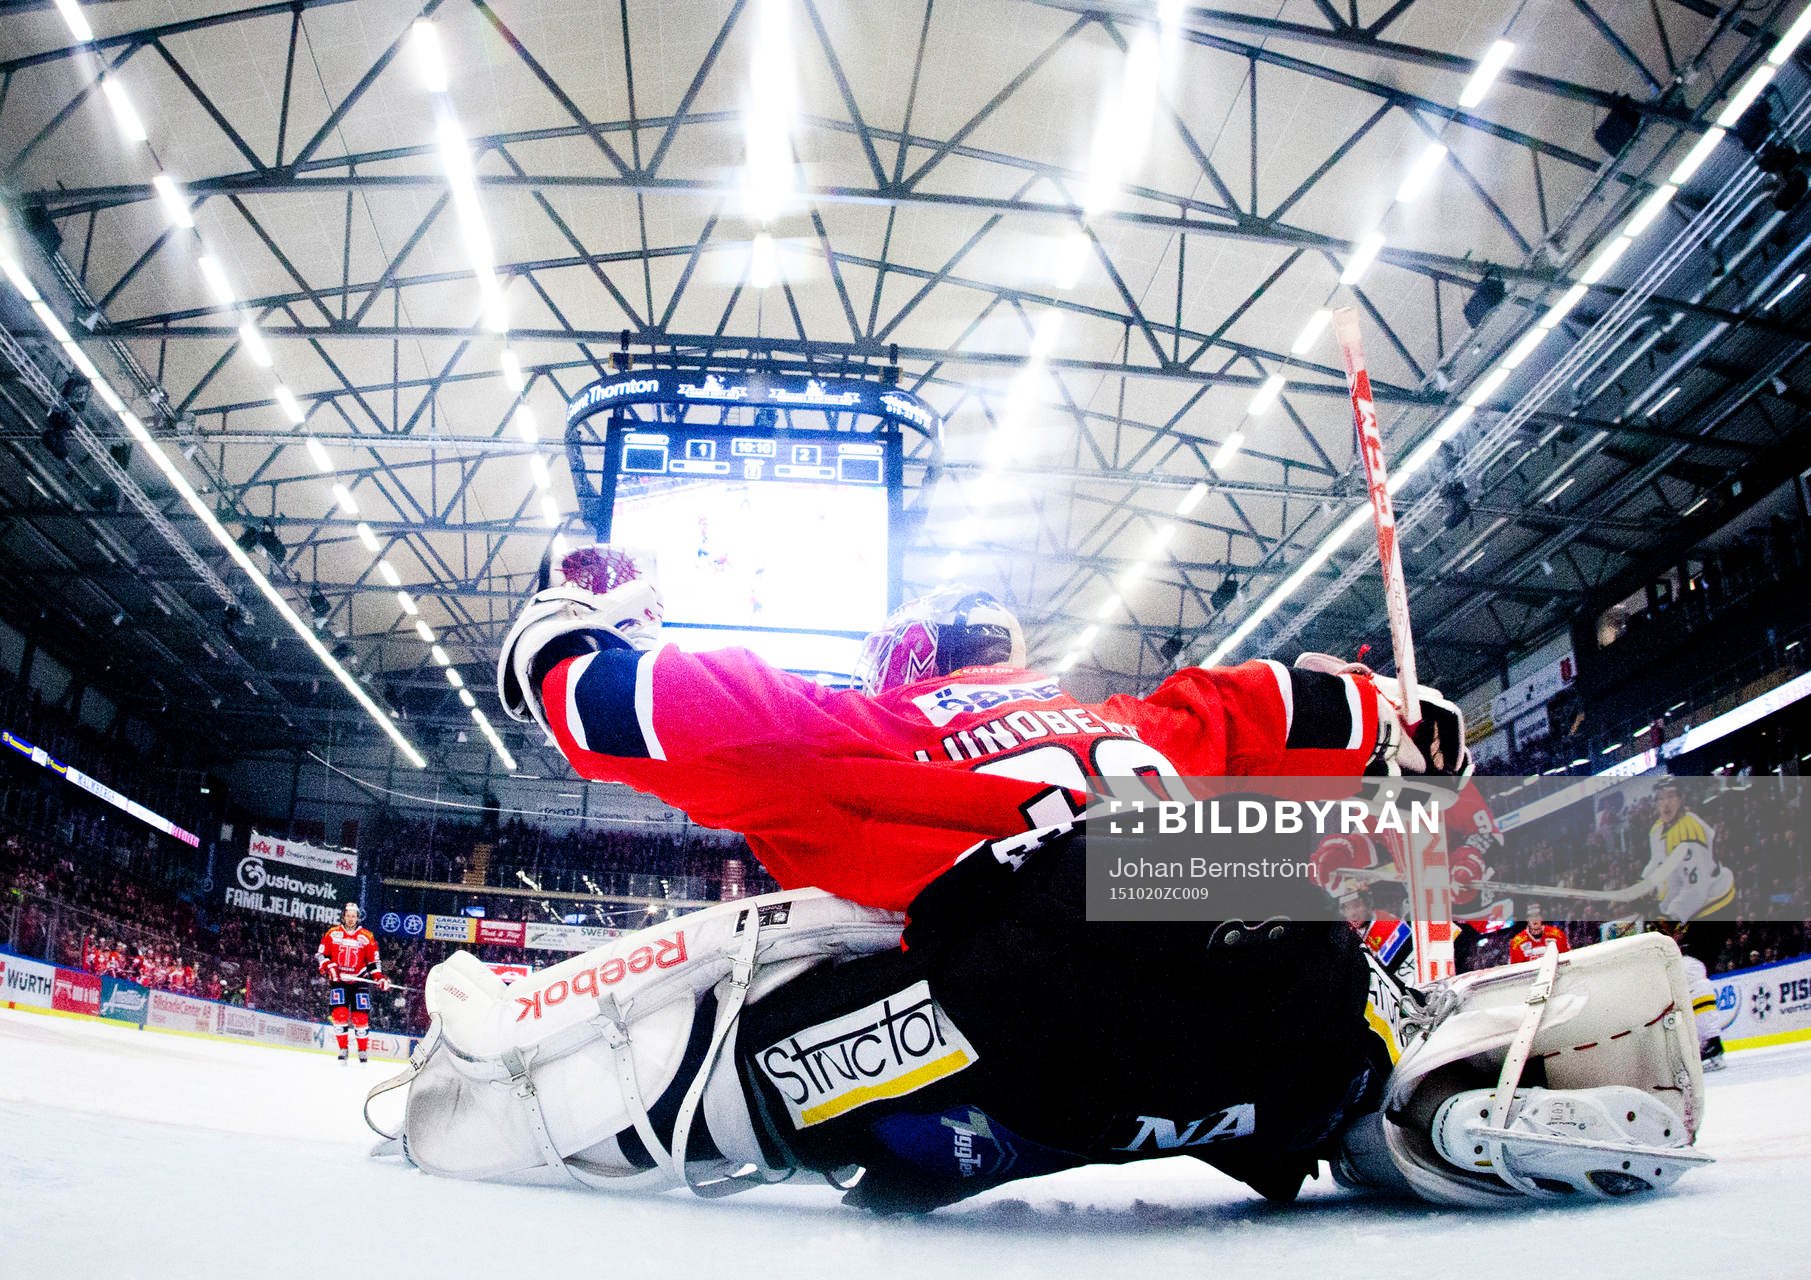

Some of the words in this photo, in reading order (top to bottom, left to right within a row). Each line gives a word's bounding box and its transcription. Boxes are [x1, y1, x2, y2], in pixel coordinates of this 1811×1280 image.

[589, 379, 659, 404] Thornton
[798, 448, 810, 462] 2
[236, 856, 338, 900] Gustavsvik
[7, 968, 52, 996] WÜRTH
[516, 930, 689, 1022] Reebok
[1779, 975, 1811, 1004] PIS
[763, 998, 947, 1105] Structor
